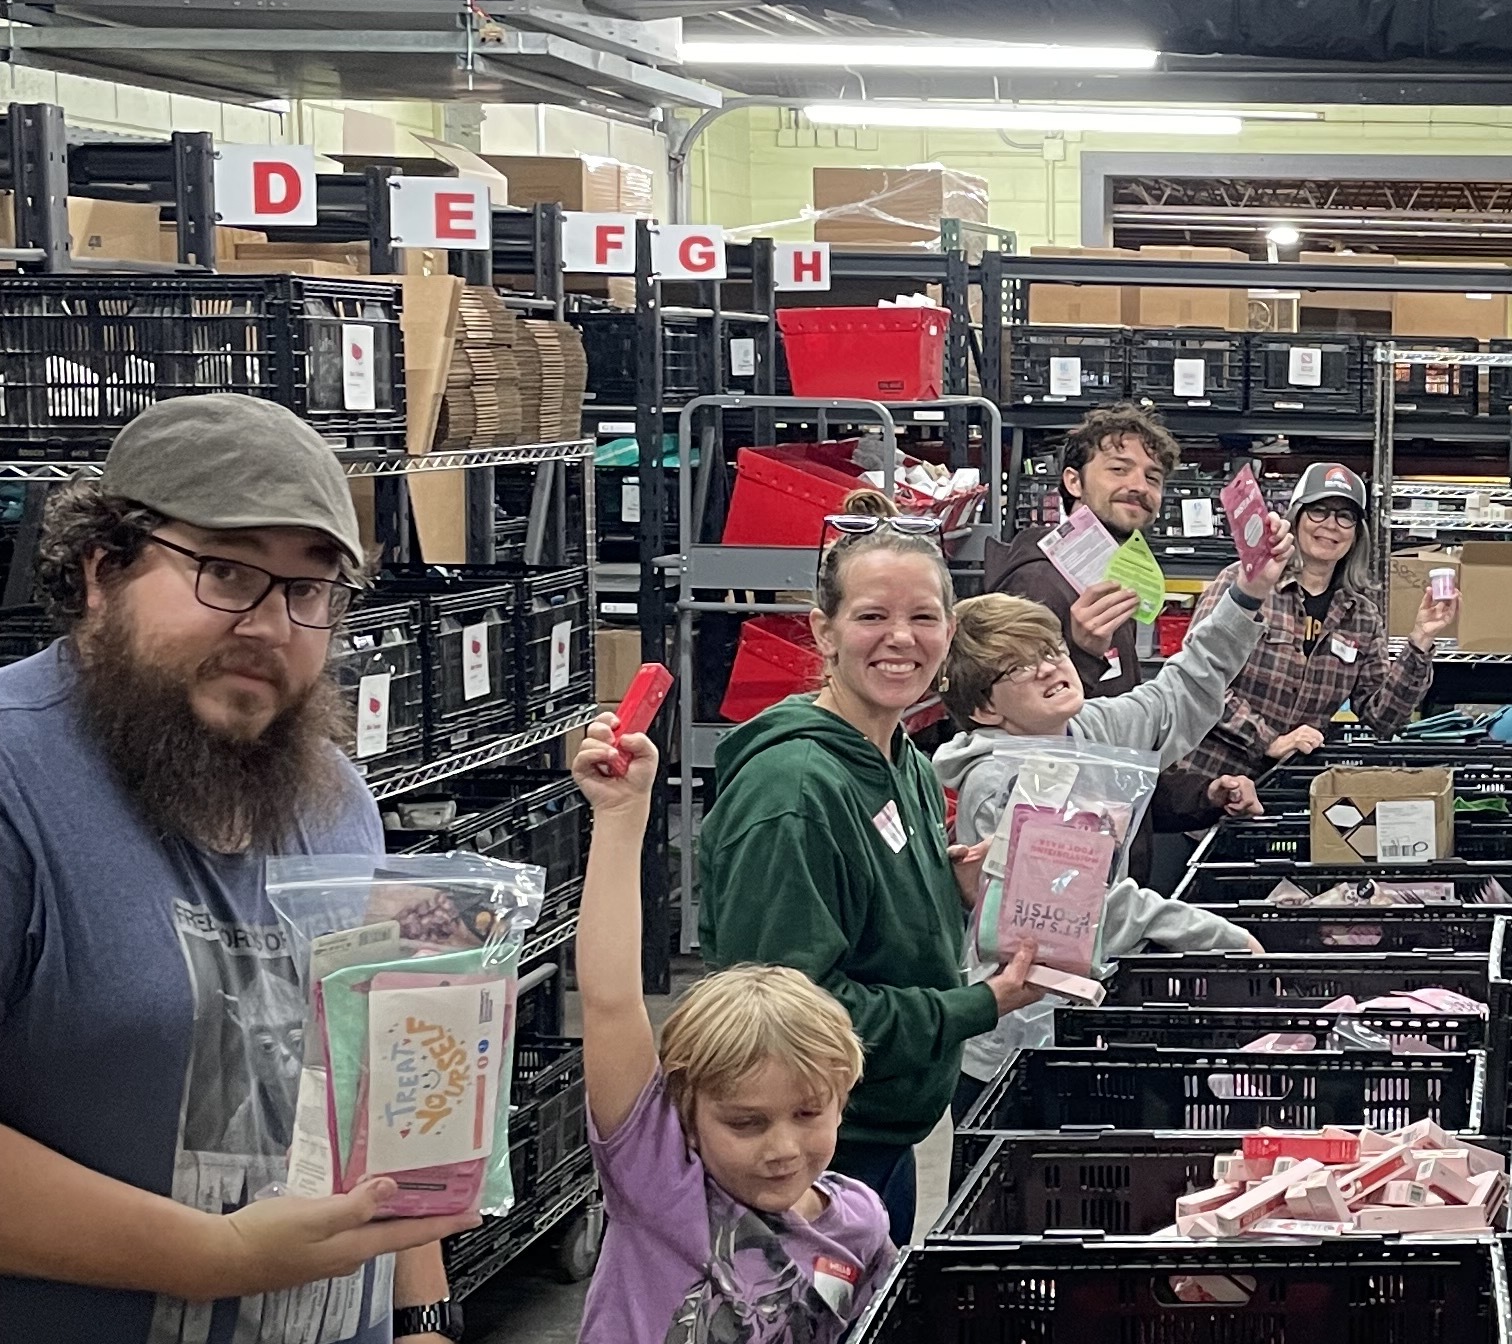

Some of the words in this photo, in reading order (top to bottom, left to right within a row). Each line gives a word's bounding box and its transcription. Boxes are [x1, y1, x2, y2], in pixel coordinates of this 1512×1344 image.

[253, 161, 301, 215] D
[434, 193, 477, 239] E
[595, 225, 626, 265] F
[678, 235, 717, 272] G
[793, 251, 822, 283] H
[1012, 914, 1045, 929] PLAY
[385, 1041, 418, 1128] TREAT
[405, 1016, 470, 1135] YOURSELF
